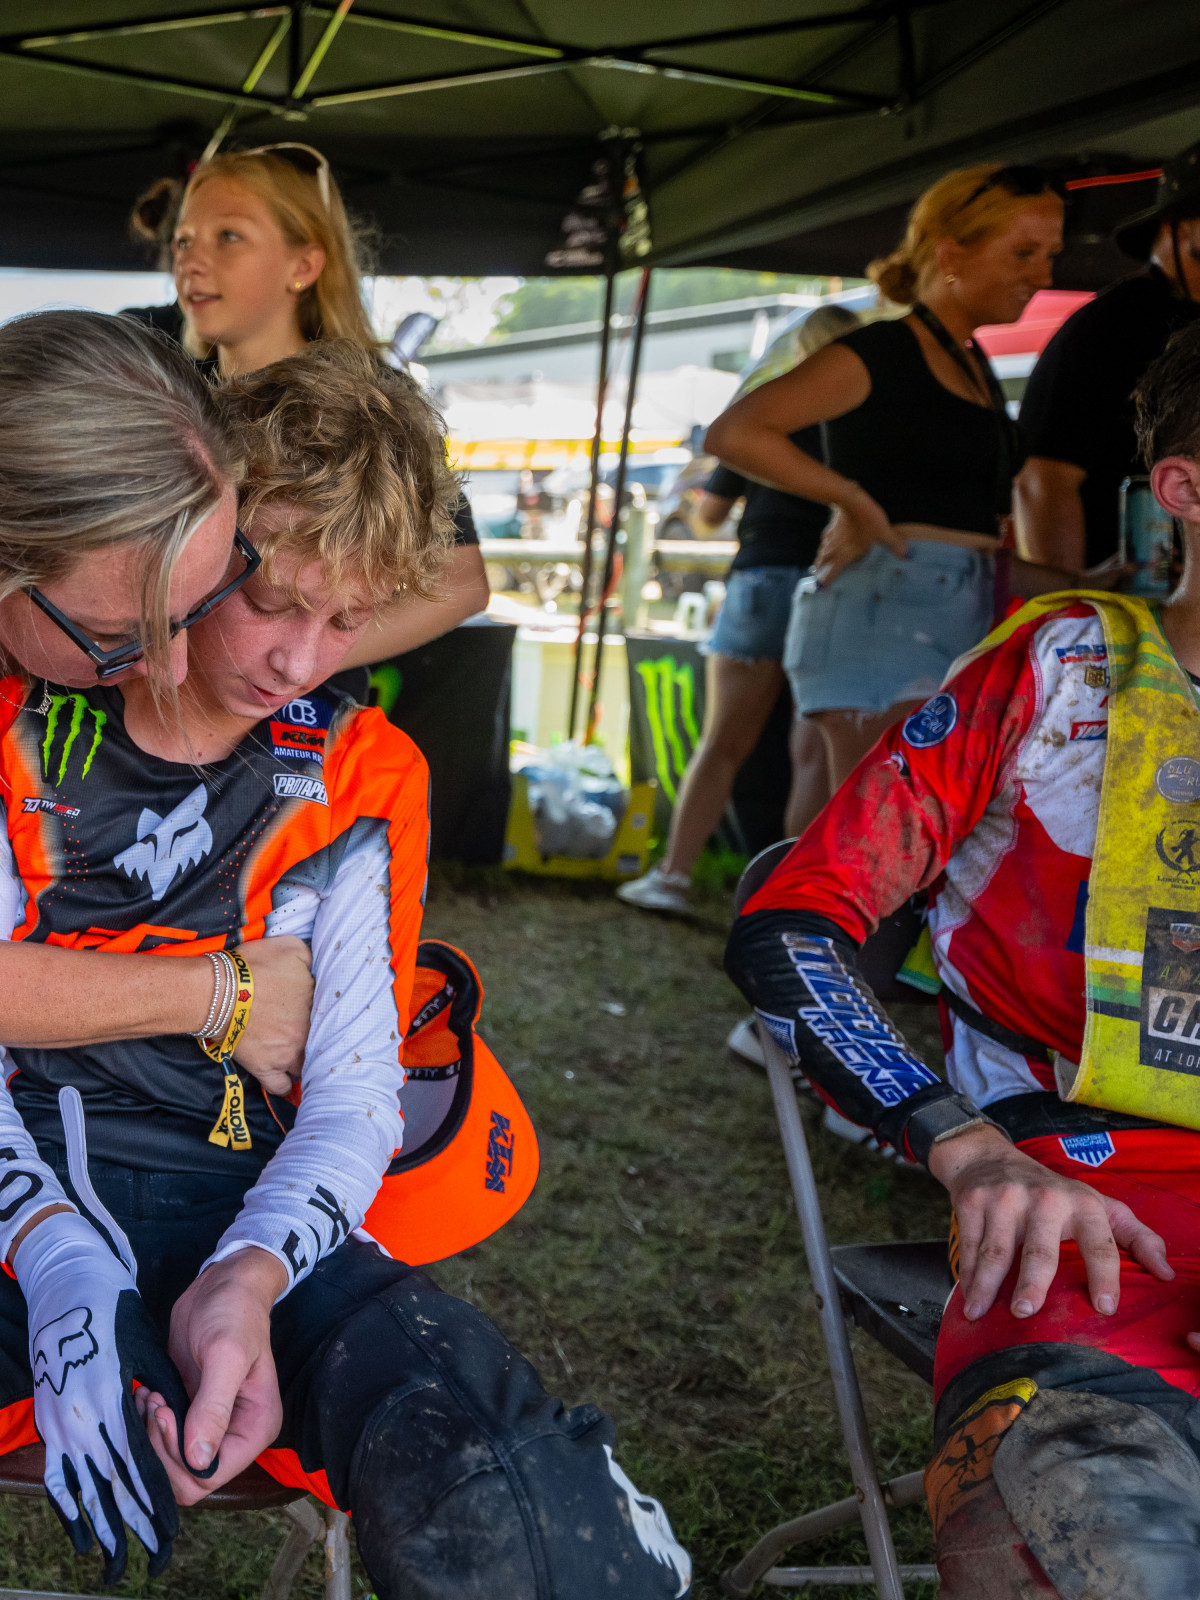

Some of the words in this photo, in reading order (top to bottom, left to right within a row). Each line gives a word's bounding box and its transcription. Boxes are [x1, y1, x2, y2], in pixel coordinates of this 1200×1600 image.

[274, 746, 311, 759] AMATEUR
[281, 730, 326, 748] KTM
[798, 1007, 903, 1108] RACING
[1154, 1048, 1173, 1064] AT
[228, 1079, 249, 1142] MOTO-X
[485, 1110, 514, 1193] KTM
